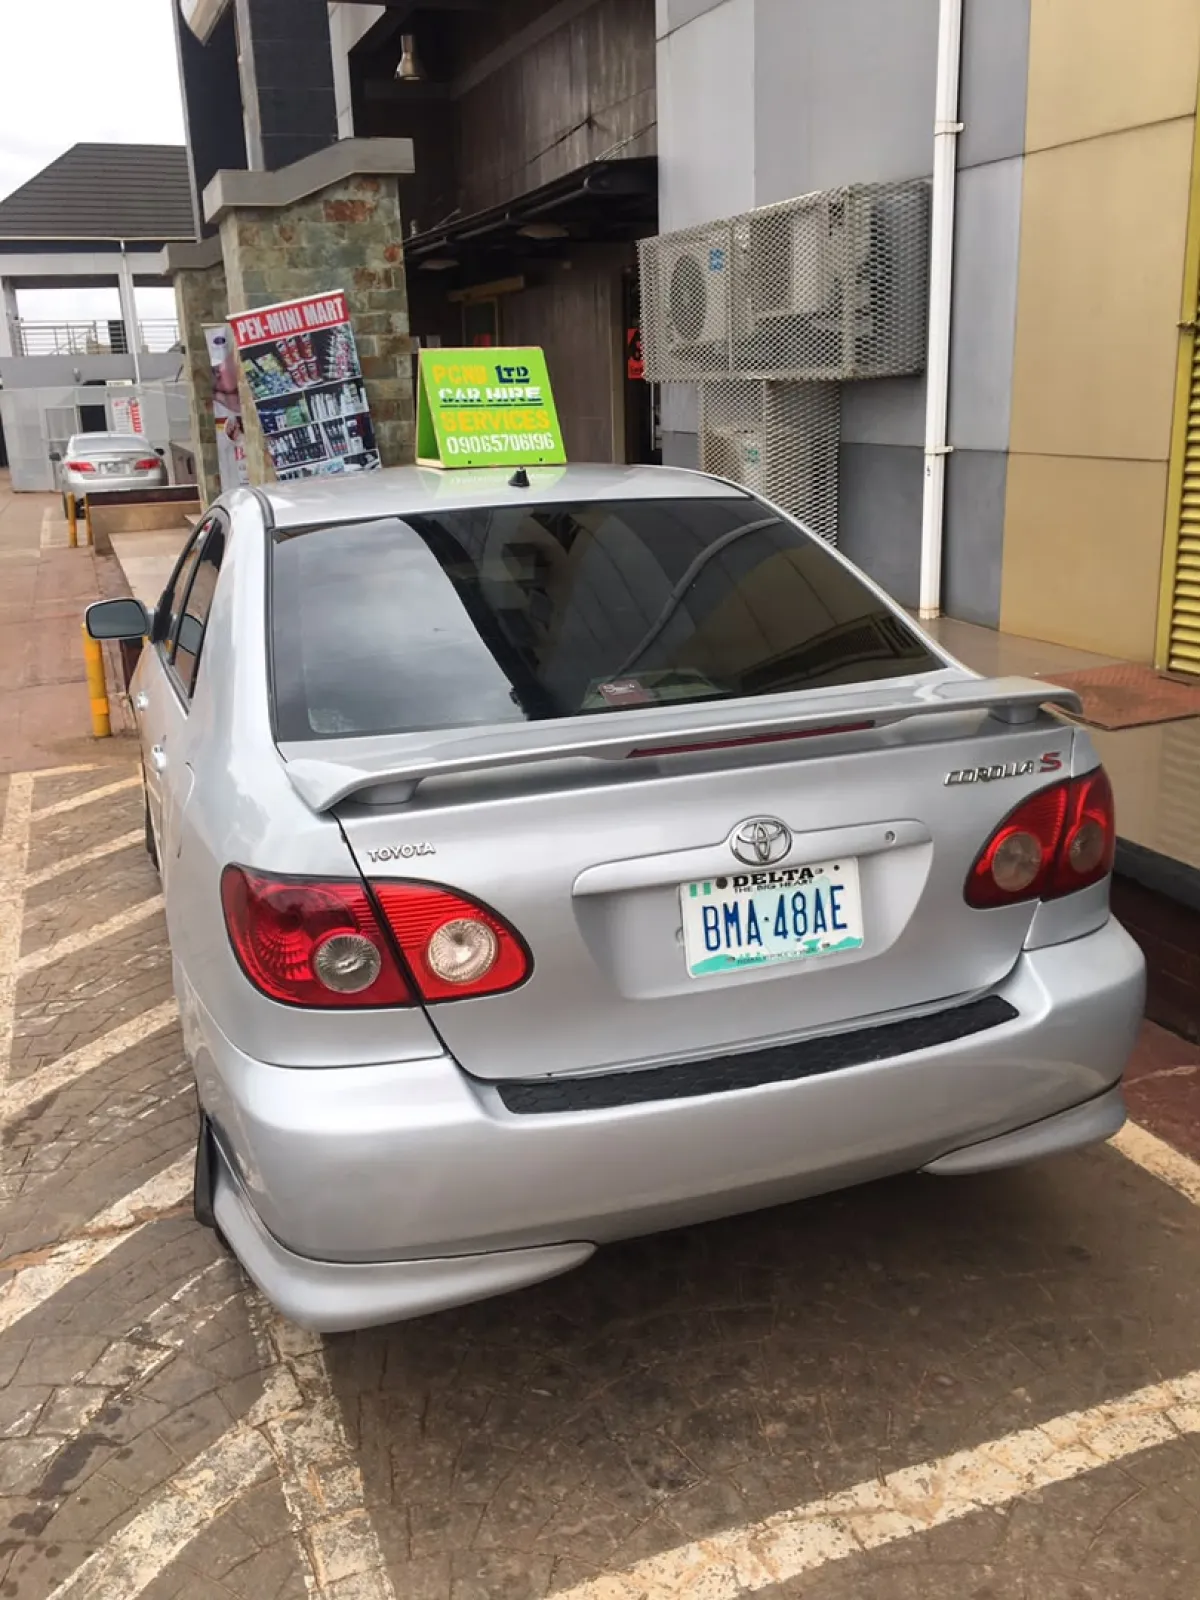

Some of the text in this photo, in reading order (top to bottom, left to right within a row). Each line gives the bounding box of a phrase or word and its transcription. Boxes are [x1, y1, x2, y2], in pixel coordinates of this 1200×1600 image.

[302, 297, 345, 327] MART
[495, 365, 530, 384] LTD
[438, 386, 542, 403] CAR HIRE
[441, 410, 551, 432] SERVICES
[944, 752, 1062, 787] COROLLA S
[366, 842, 436, 862] TOYOTA
[733, 867, 814, 887] DELTA
